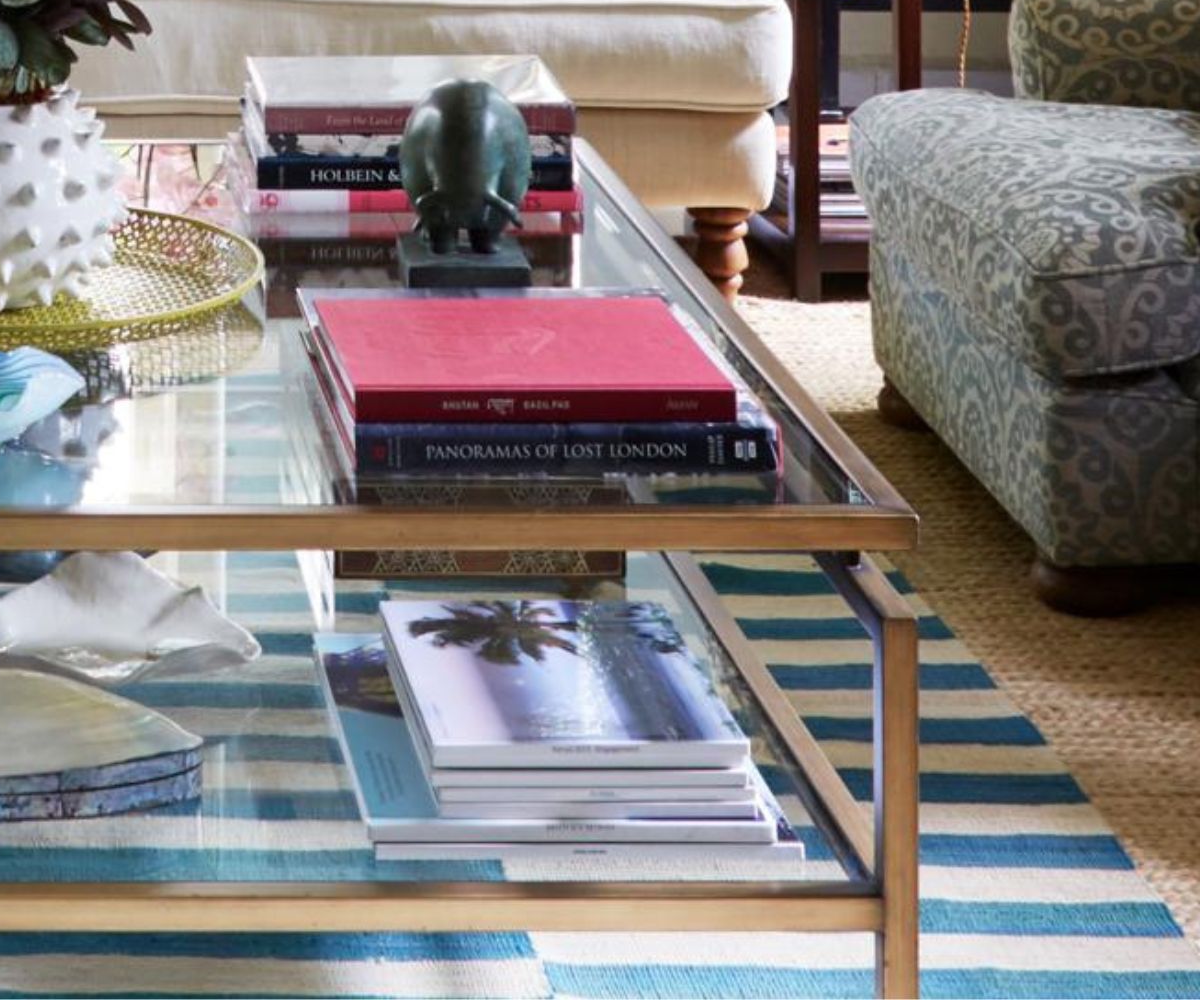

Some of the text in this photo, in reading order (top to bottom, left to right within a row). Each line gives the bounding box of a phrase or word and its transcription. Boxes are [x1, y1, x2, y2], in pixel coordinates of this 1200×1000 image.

[310, 169, 383, 183] HOLBEIN
[425, 441, 688, 460] PANORAMAS OF LOST LONDON
